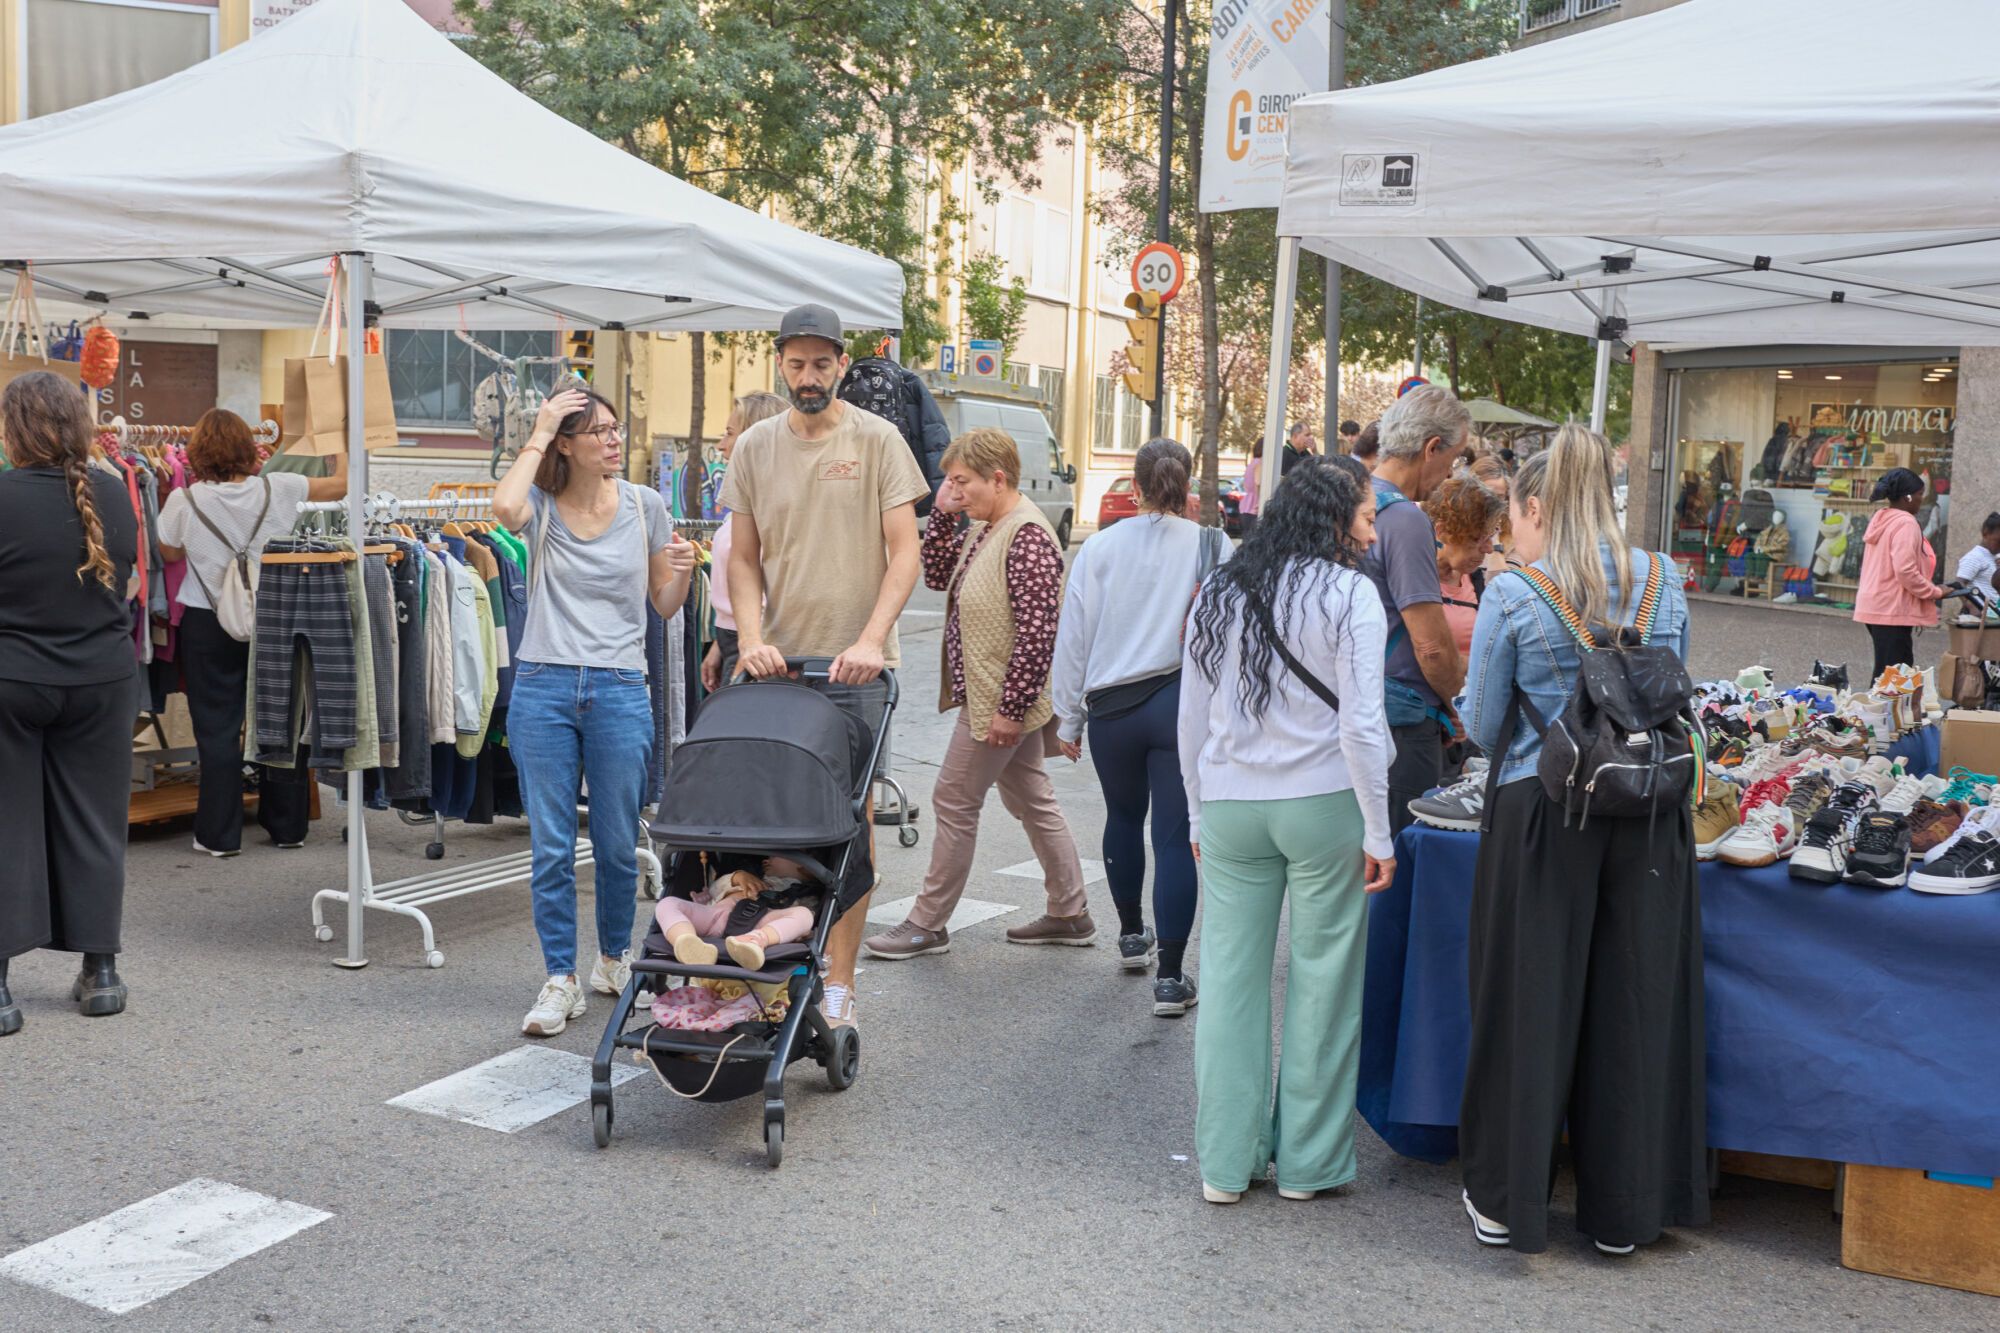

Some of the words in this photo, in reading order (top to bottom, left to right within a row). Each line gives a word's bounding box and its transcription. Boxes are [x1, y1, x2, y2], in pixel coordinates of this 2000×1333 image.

[268, 6, 300, 16] BATX
[1247, 44, 1271, 72] HORTES
[1259, 92, 1307, 114] GIRO
[1143, 263, 1171, 284] 30
[943, 347, 953, 371] P
